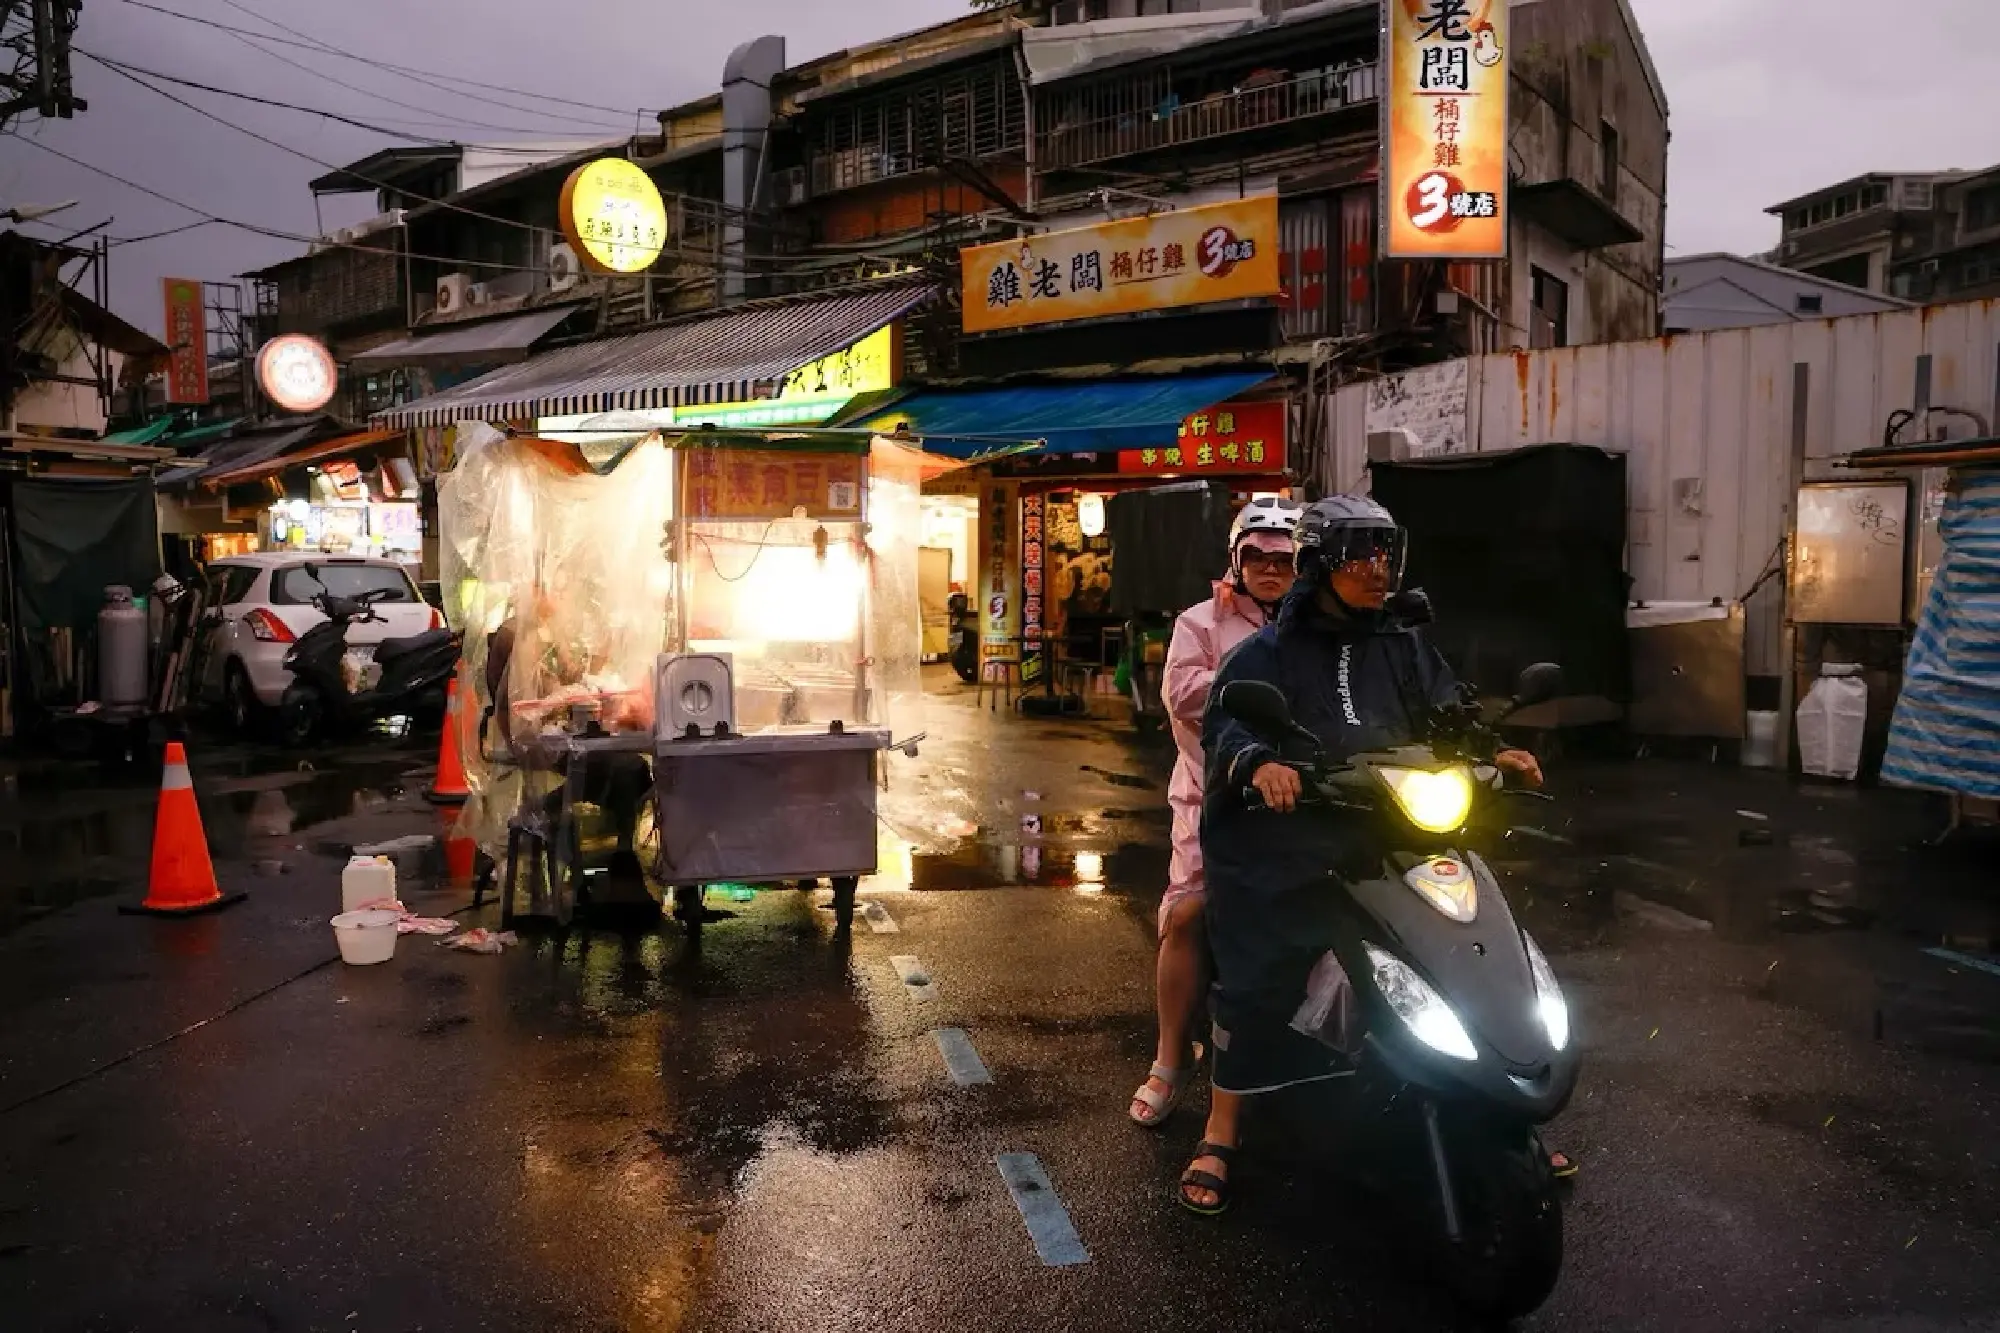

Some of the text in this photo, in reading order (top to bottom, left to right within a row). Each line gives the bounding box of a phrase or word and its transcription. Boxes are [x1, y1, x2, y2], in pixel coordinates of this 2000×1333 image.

[1433, 98, 1461, 168] 桶仔雞
[987, 250, 1102, 308] 雞老闆
[1110, 243, 1186, 279] 桶仔雞
[1197, 440, 1265, 466] 生啤酒
[1337, 644, 1361, 726] Waterproof
